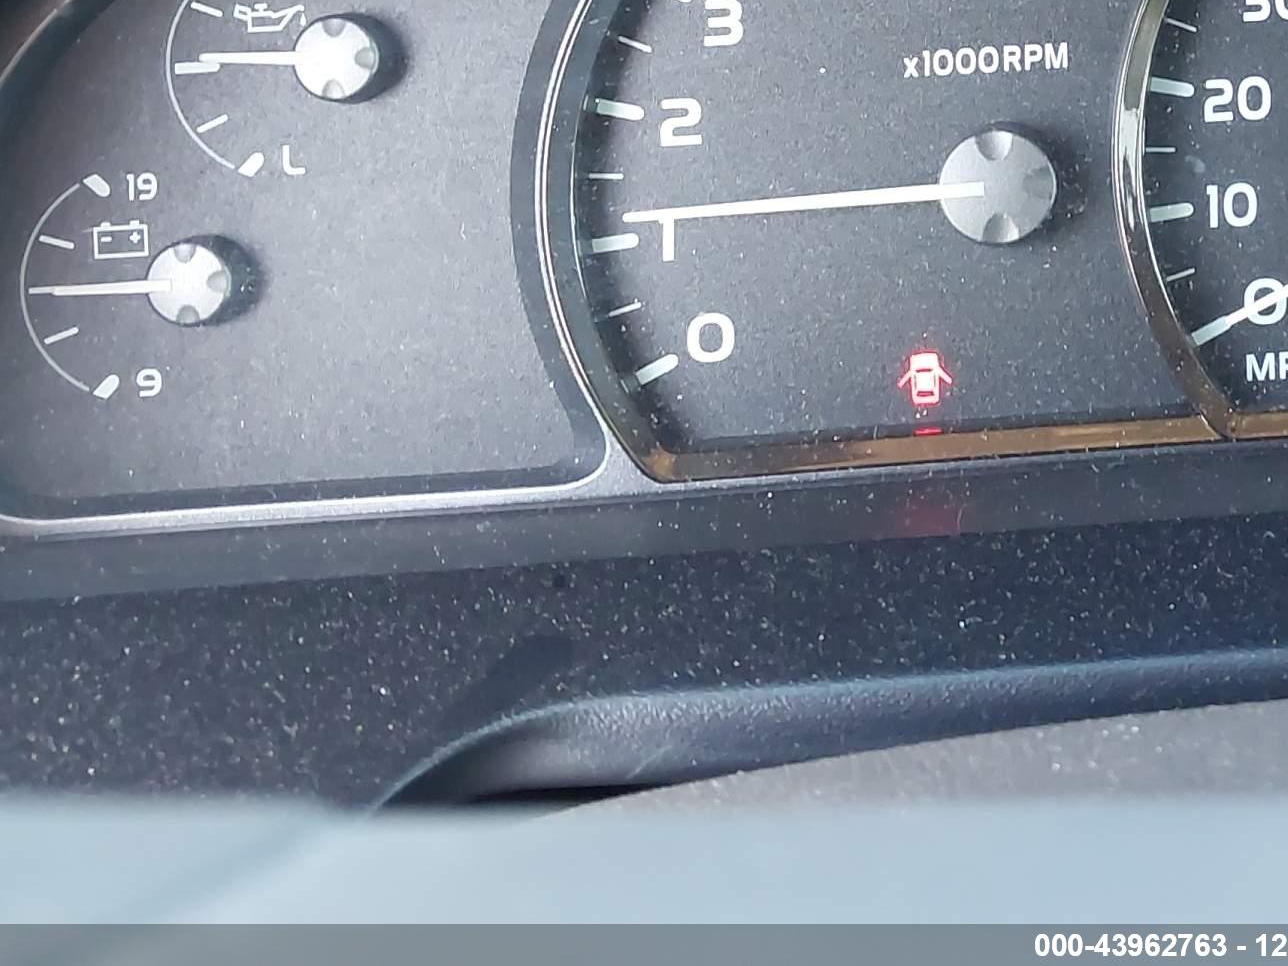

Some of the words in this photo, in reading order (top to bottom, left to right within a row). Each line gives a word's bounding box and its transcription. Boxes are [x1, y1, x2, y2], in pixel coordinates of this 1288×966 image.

[659, 97, 703, 147] 2
[1203, 75, 1272, 123] 20
[281, 144, 307, 176] L
[126, 173, 158, 202] 19
[1205, 182, 1258, 230] 10
[658, 210, 676, 262] 1
[1243, 277, 1288, 325] 0
[686, 312, 735, 363] 0
[136, 368, 162, 397] 9
